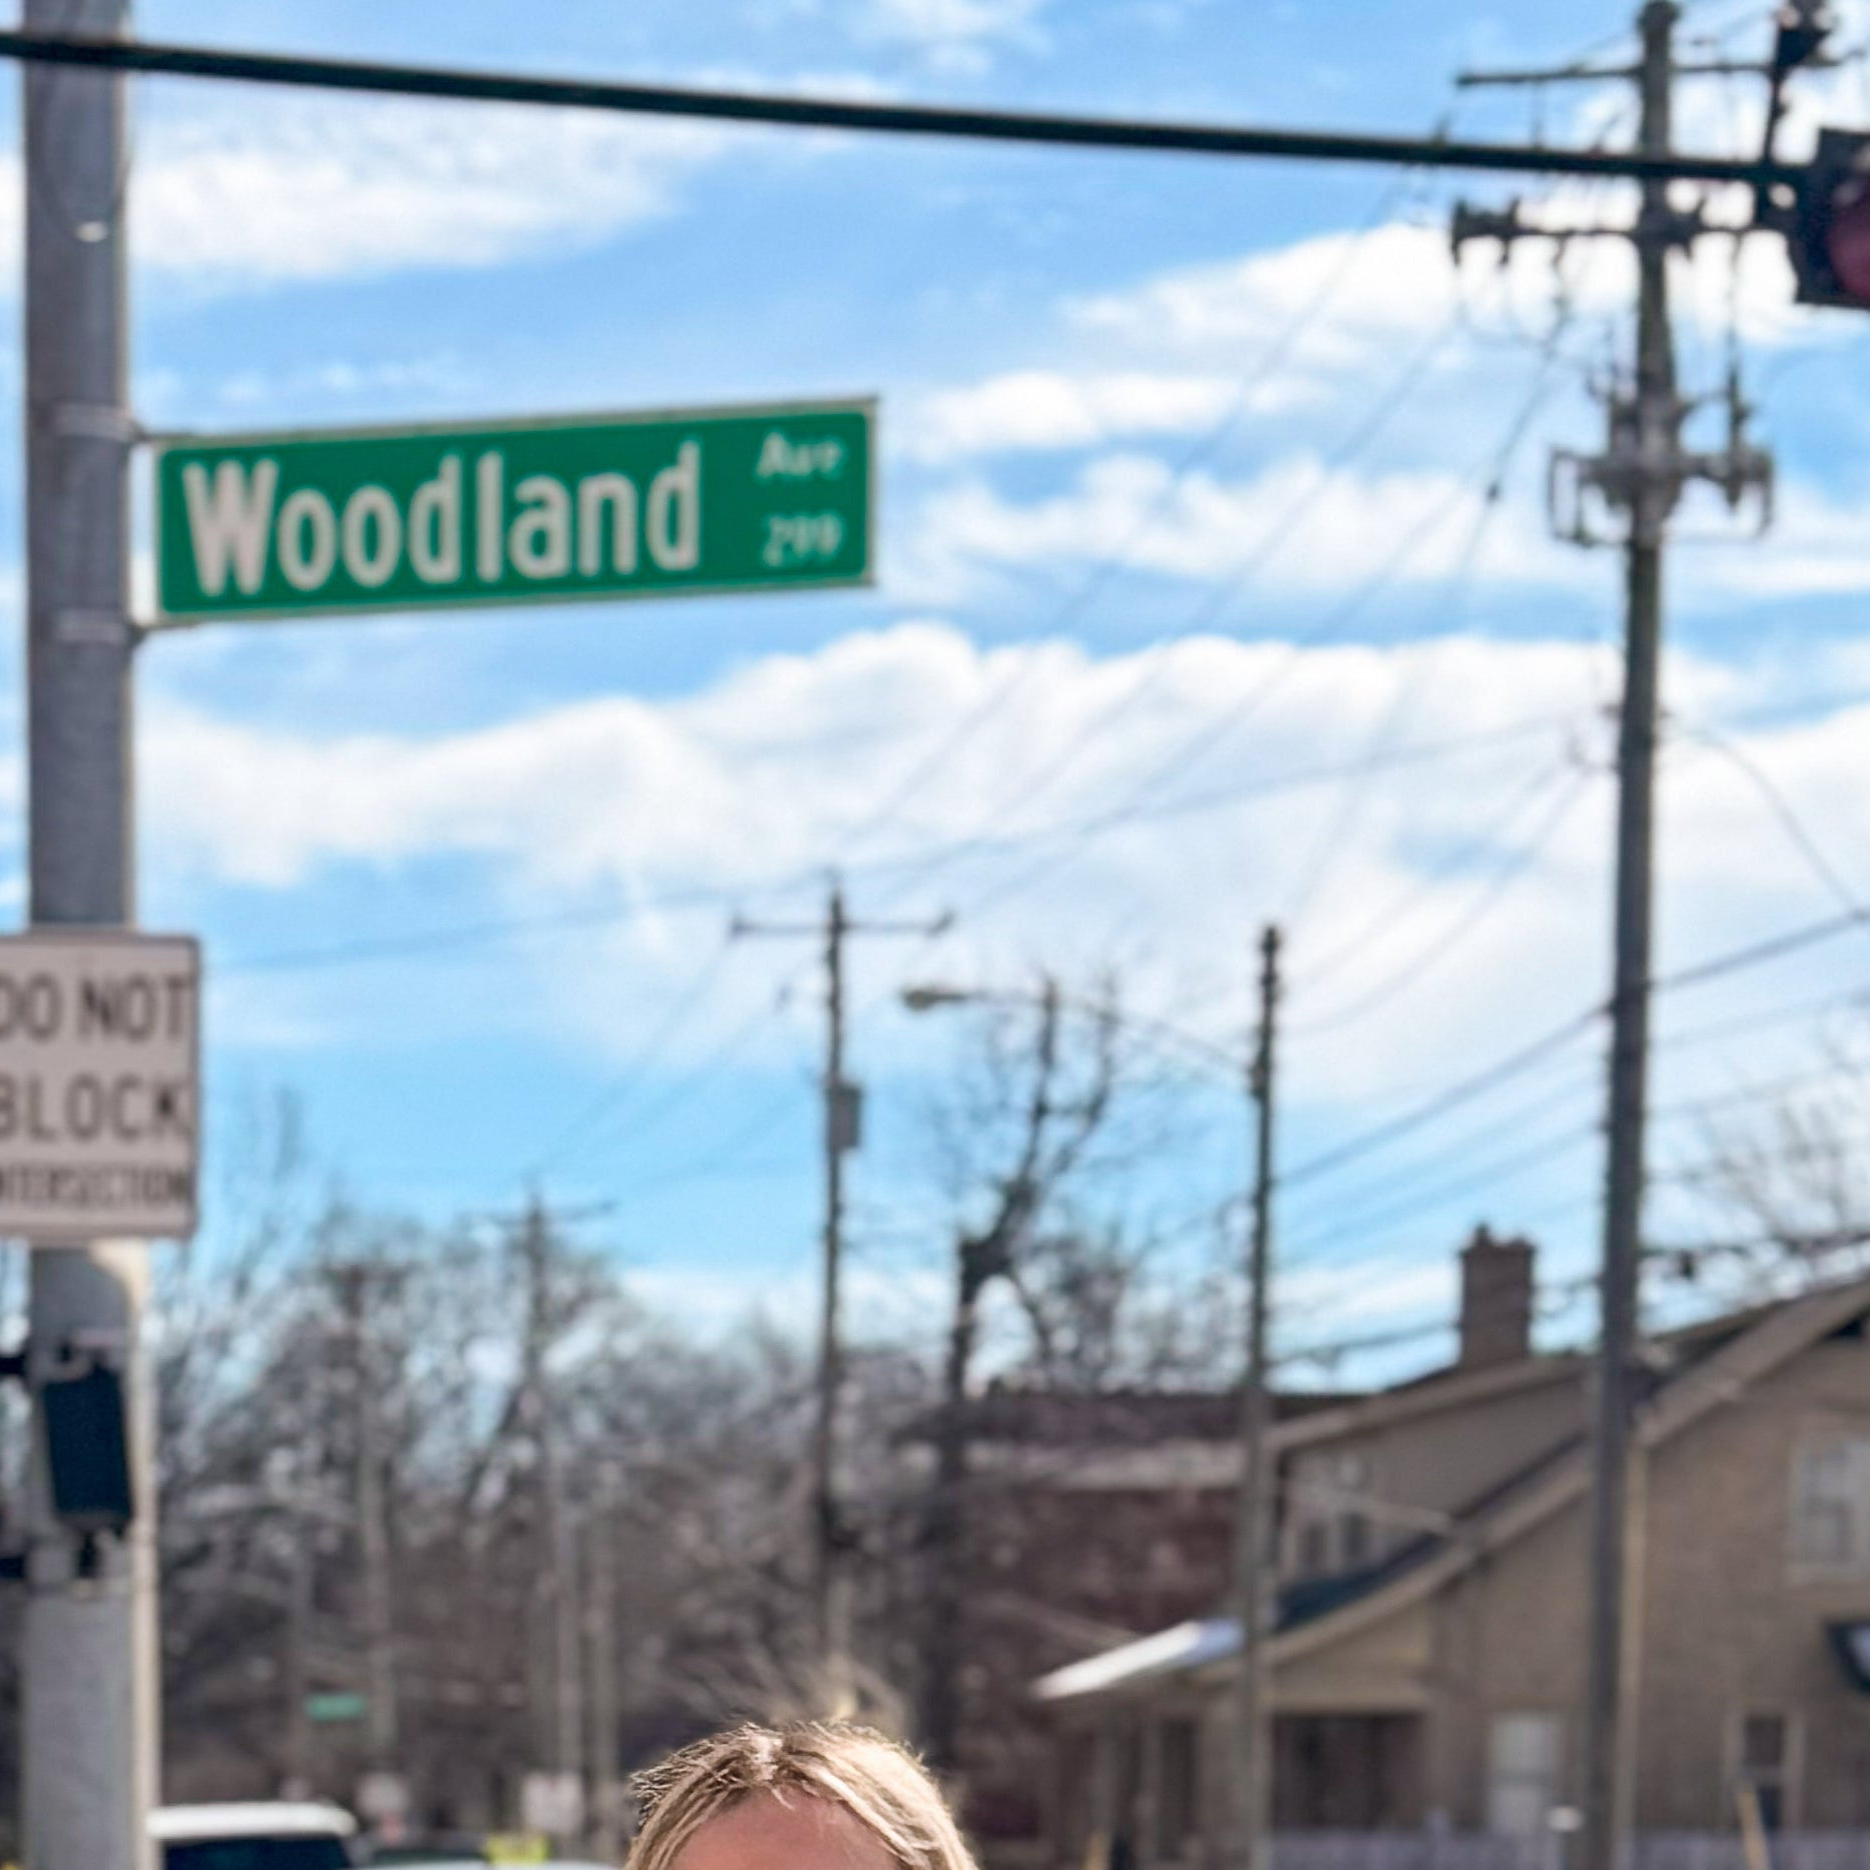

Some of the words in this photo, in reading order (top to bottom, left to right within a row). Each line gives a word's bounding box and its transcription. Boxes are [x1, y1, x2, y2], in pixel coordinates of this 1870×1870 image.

[181, 438, 702, 597] Woodland
[754, 430, 846, 480] Ave
[78, 972, 192, 1042] NOT
